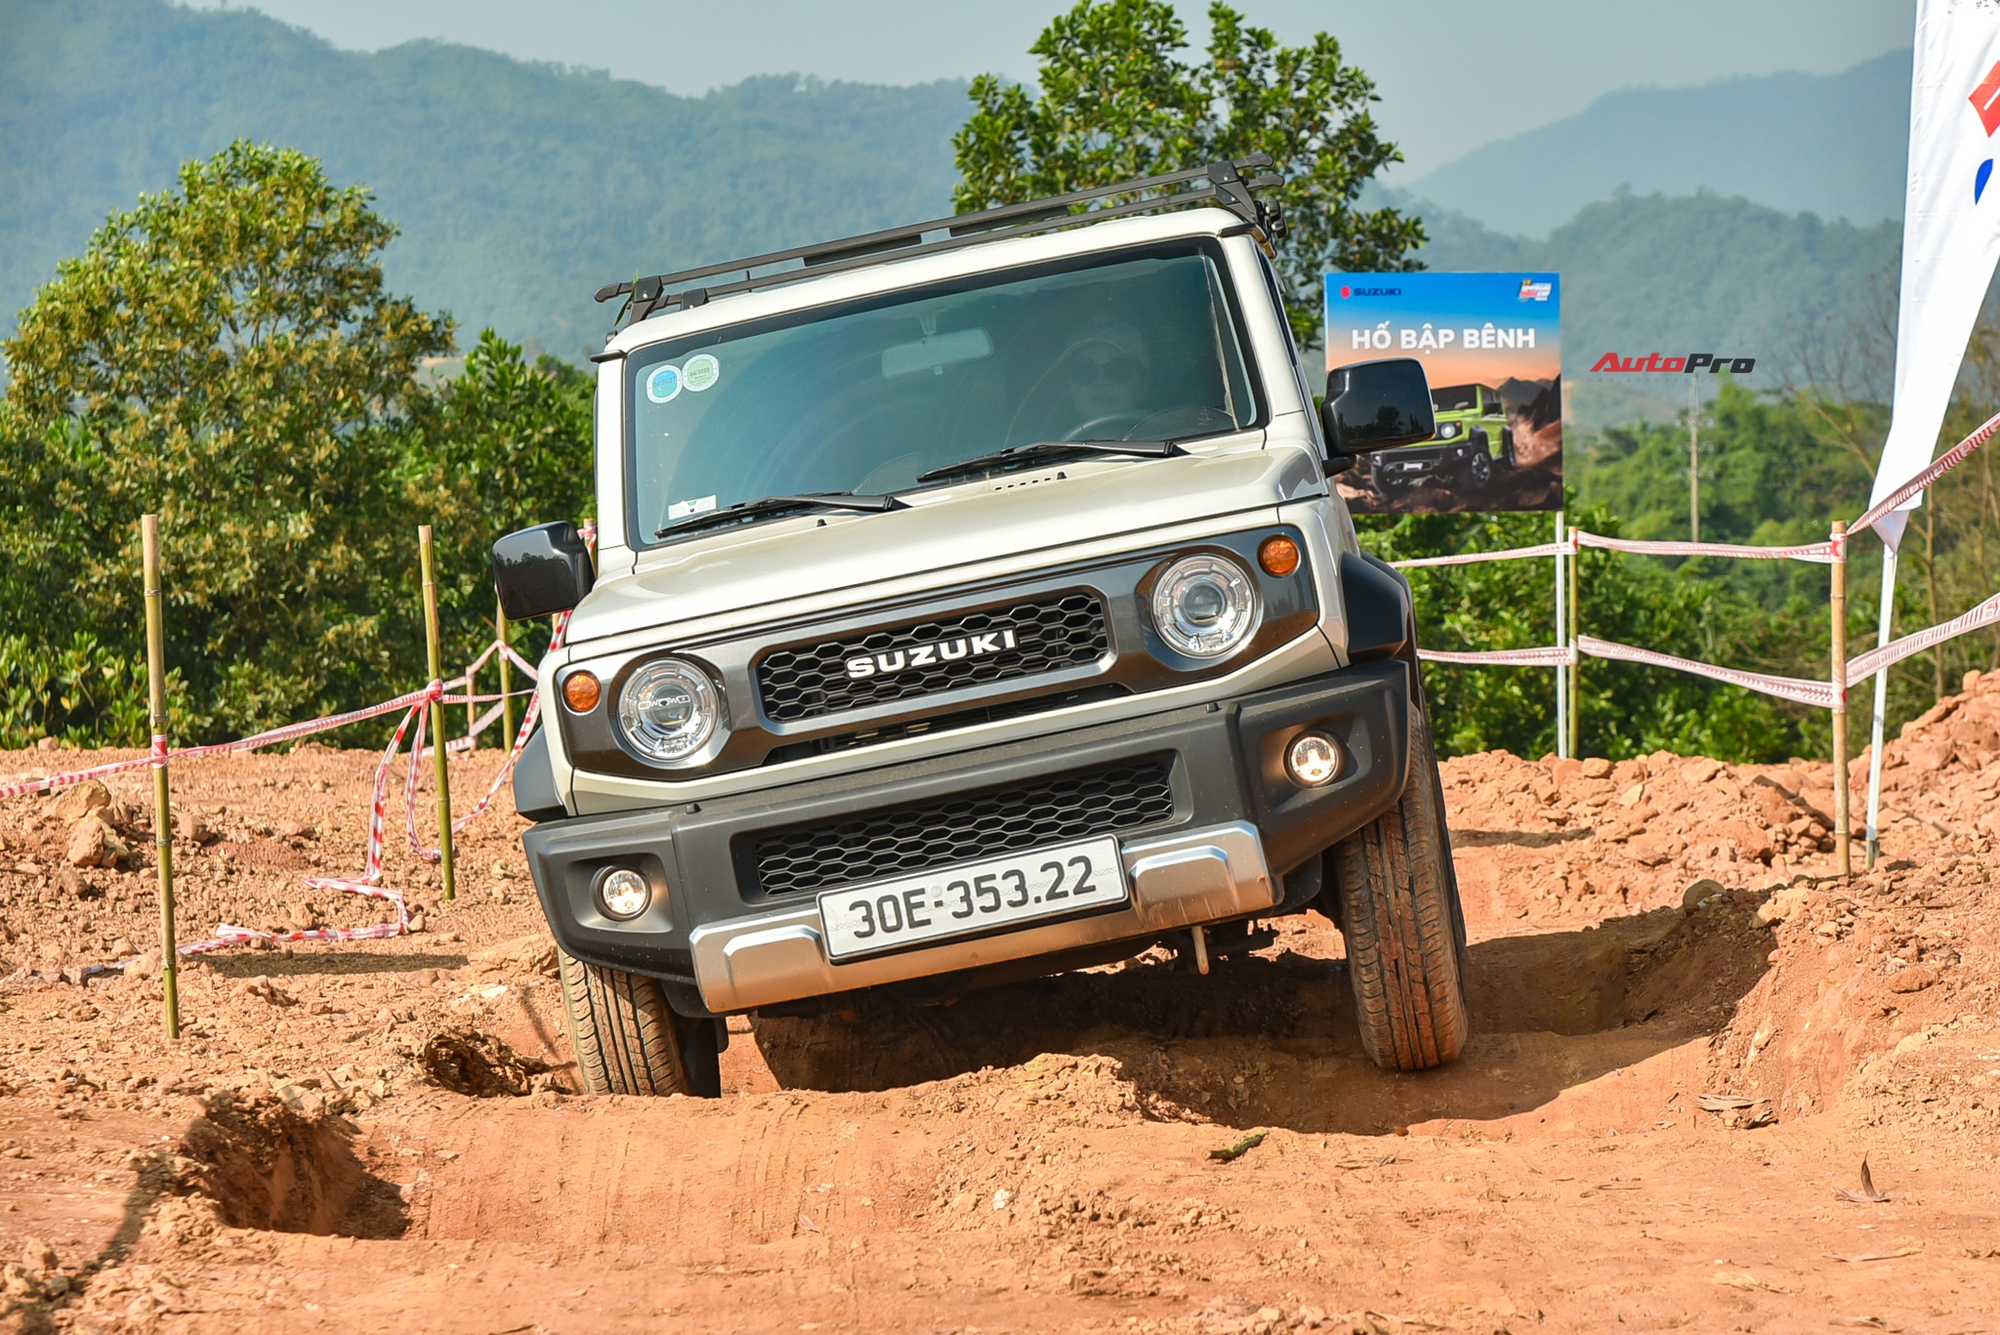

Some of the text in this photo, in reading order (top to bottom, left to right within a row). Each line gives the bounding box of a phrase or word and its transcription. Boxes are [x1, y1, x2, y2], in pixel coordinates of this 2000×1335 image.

[1353, 287, 1402, 297] SUZUKI
[1351, 320, 1536, 355] HỐ BẬP BÊNH
[846, 629, 1016, 679] SUZUKI
[848, 855, 1097, 939] 30E-353.22
